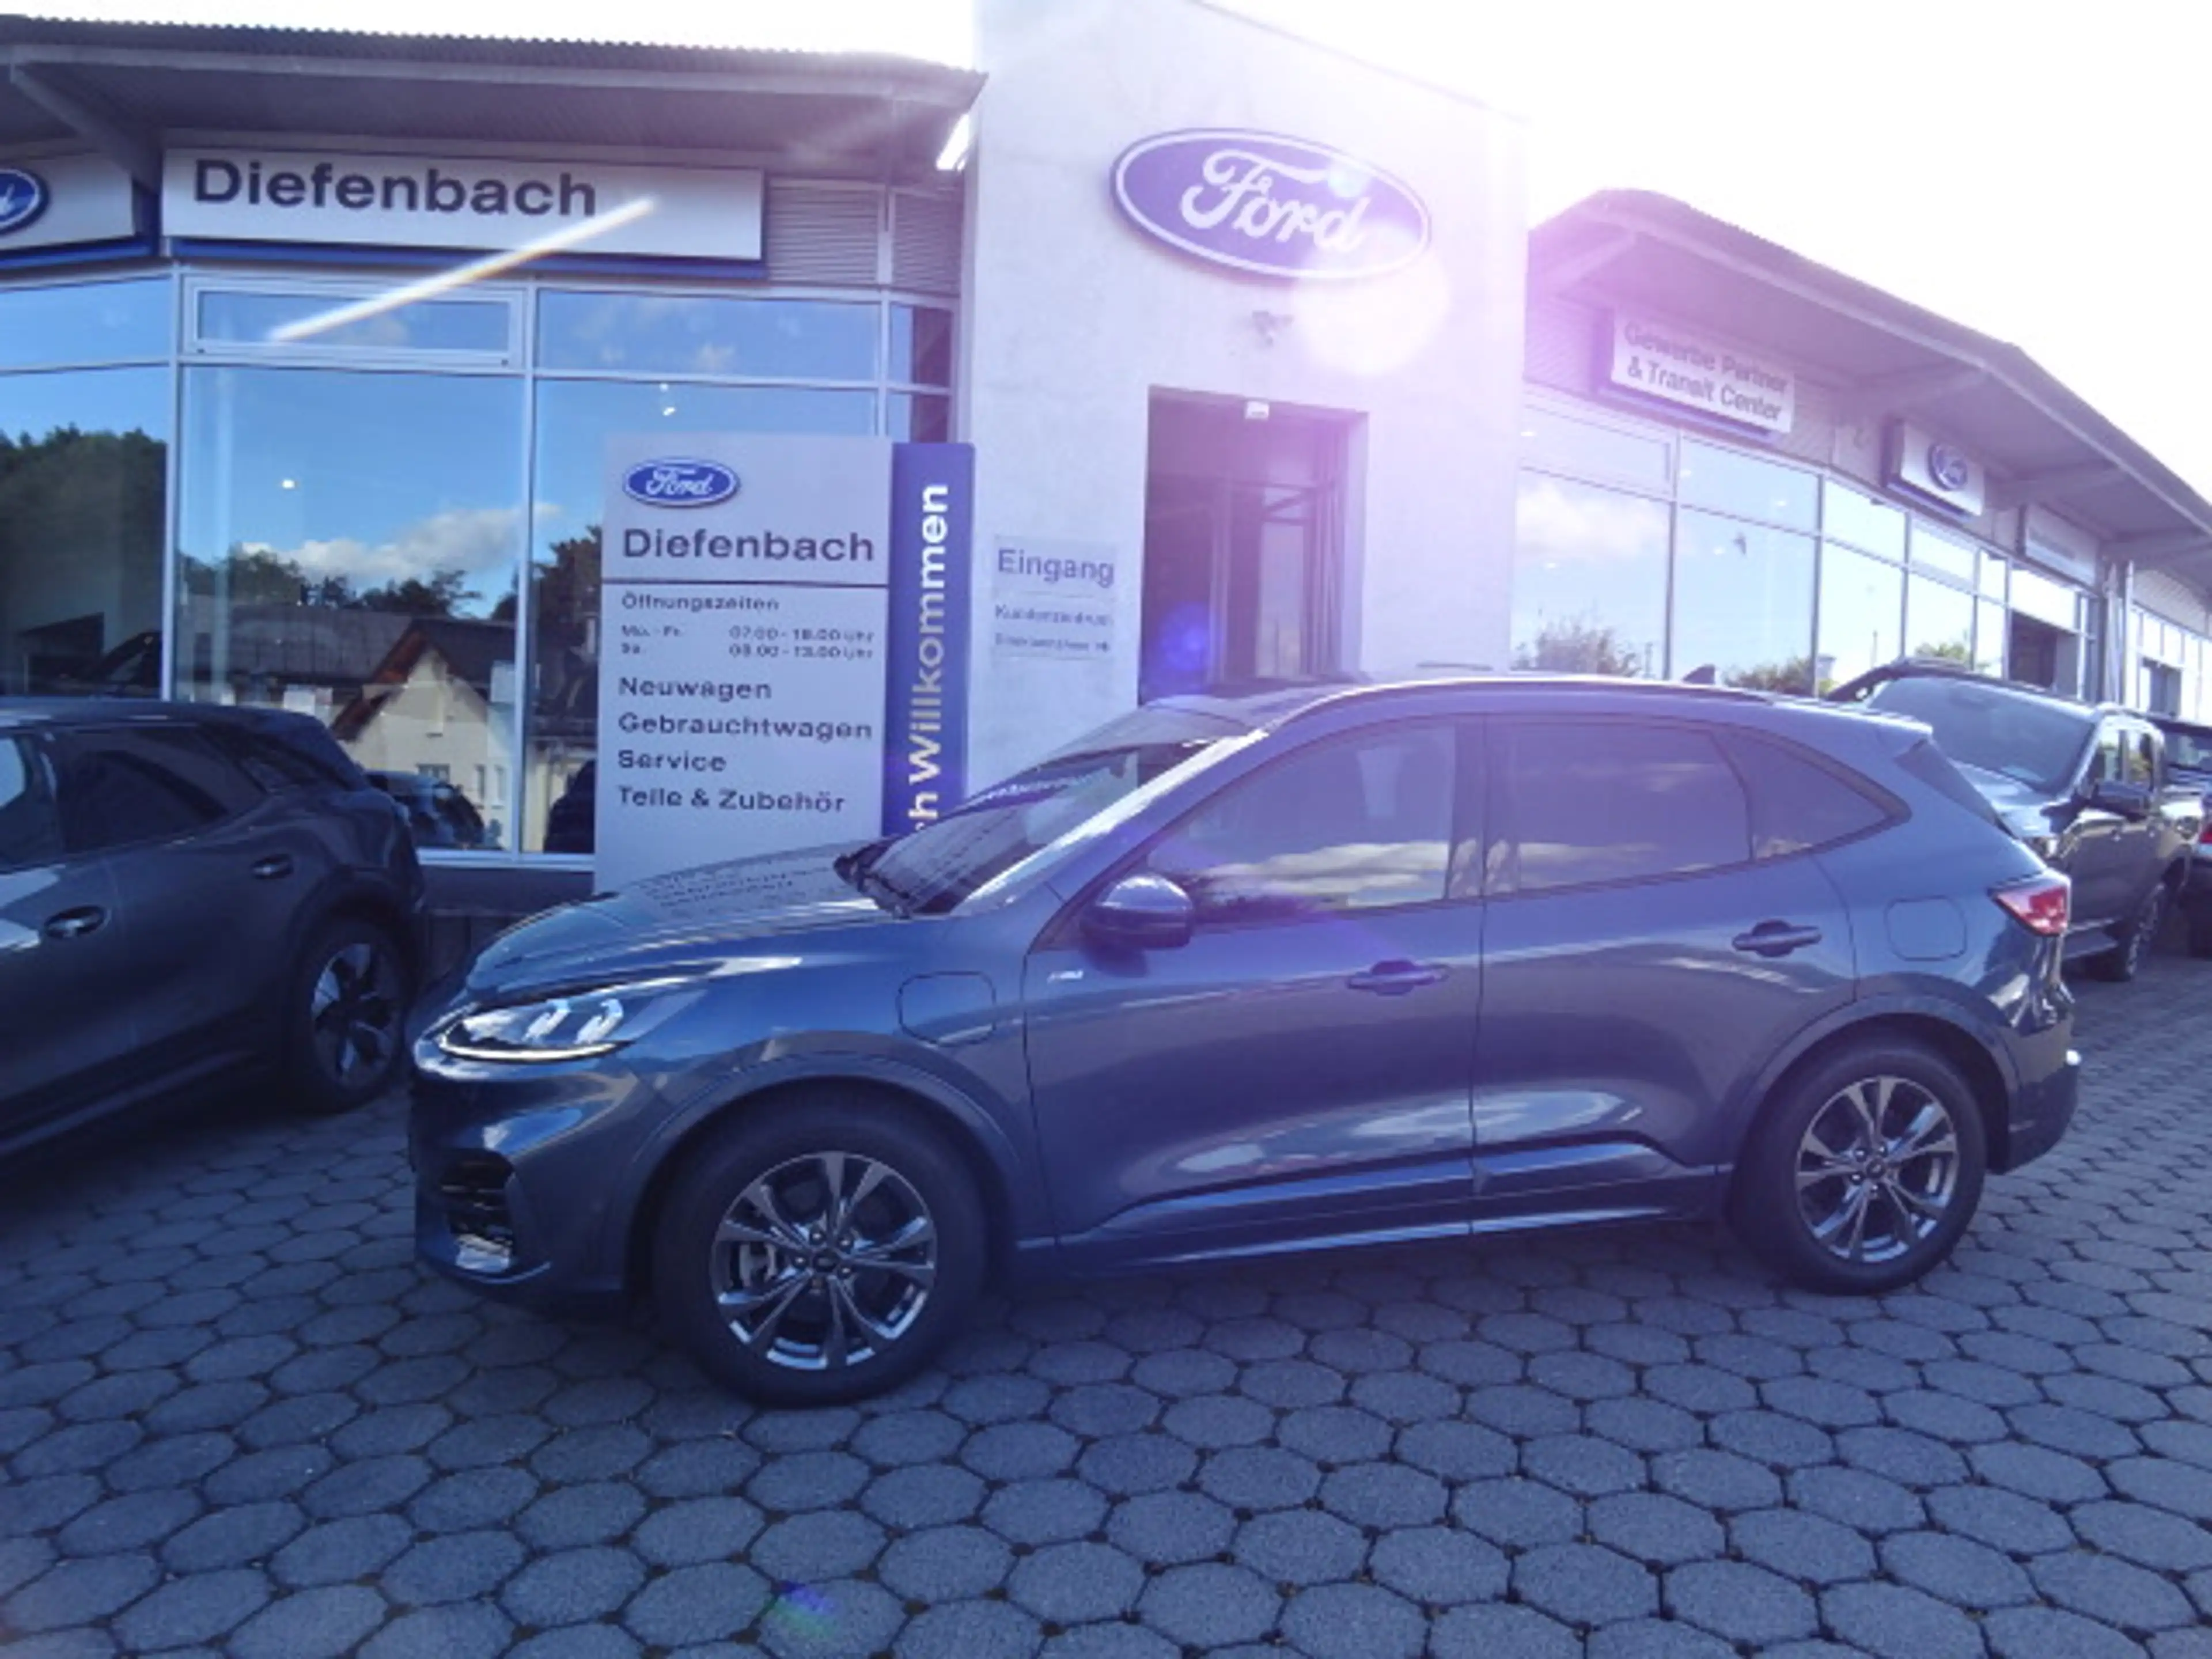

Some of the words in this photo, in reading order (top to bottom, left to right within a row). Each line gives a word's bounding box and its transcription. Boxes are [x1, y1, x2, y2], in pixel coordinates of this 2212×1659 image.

[195, 159, 595, 216] Diefenbach
[1181, 149, 1371, 252] Ford
[645, 467, 715, 496] Ford
[623, 528, 874, 562] Diefenbach
[998, 548, 1114, 589] Eingang
[622, 592, 780, 612] Öffnungszeiten
[909, 484, 949, 784] Willkommen
[619, 677, 772, 703] Neuwagen
[618, 712, 872, 742] Gebrauchtwagen
[618, 749, 727, 772] Service
[619, 786, 683, 806] Teile
[691, 789, 710, 807] &
[718, 789, 845, 813] Zubehör
